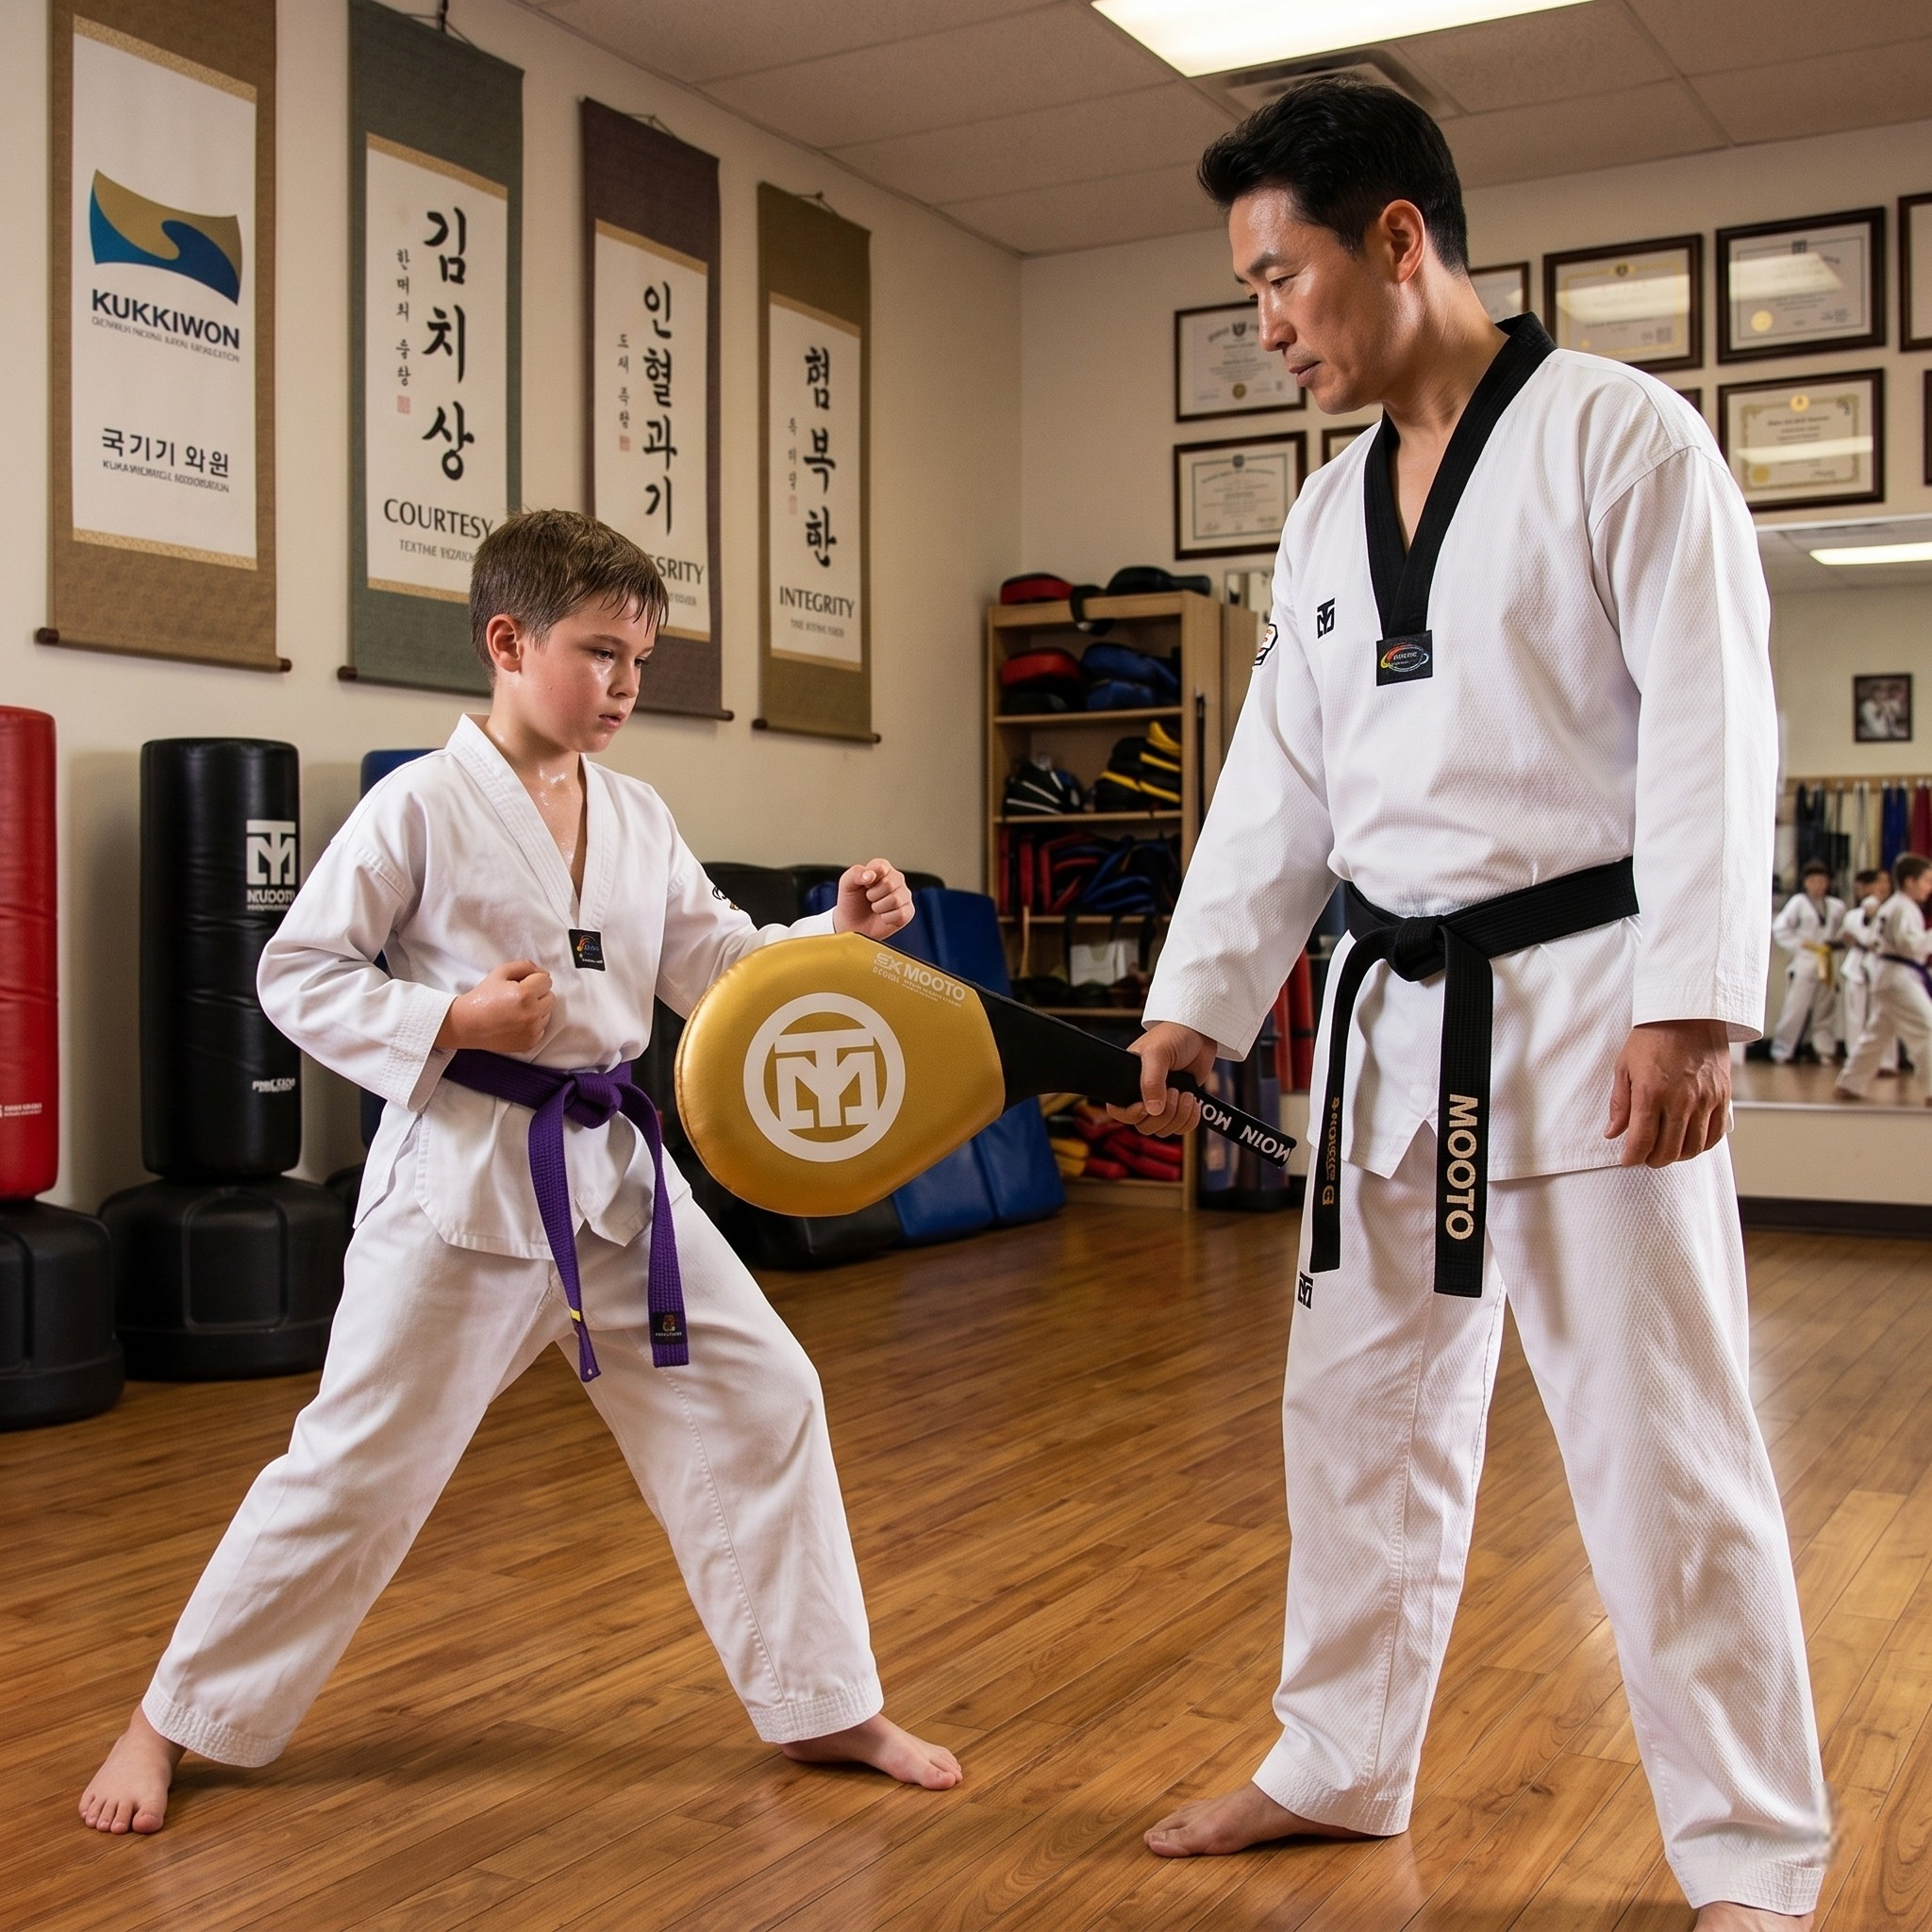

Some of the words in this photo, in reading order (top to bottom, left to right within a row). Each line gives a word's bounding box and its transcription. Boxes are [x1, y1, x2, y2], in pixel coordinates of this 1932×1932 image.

[92, 289, 240, 349] KUKKIWON
[102, 427, 176, 466] 국기기
[384, 498, 493, 539] COURTESY
[648, 554, 706, 585] SRITY
[779, 586, 855, 619] INTEGRITY
[903, 963, 966, 1001] MOOTO
[1445, 1093, 1479, 1241] MOOTO
